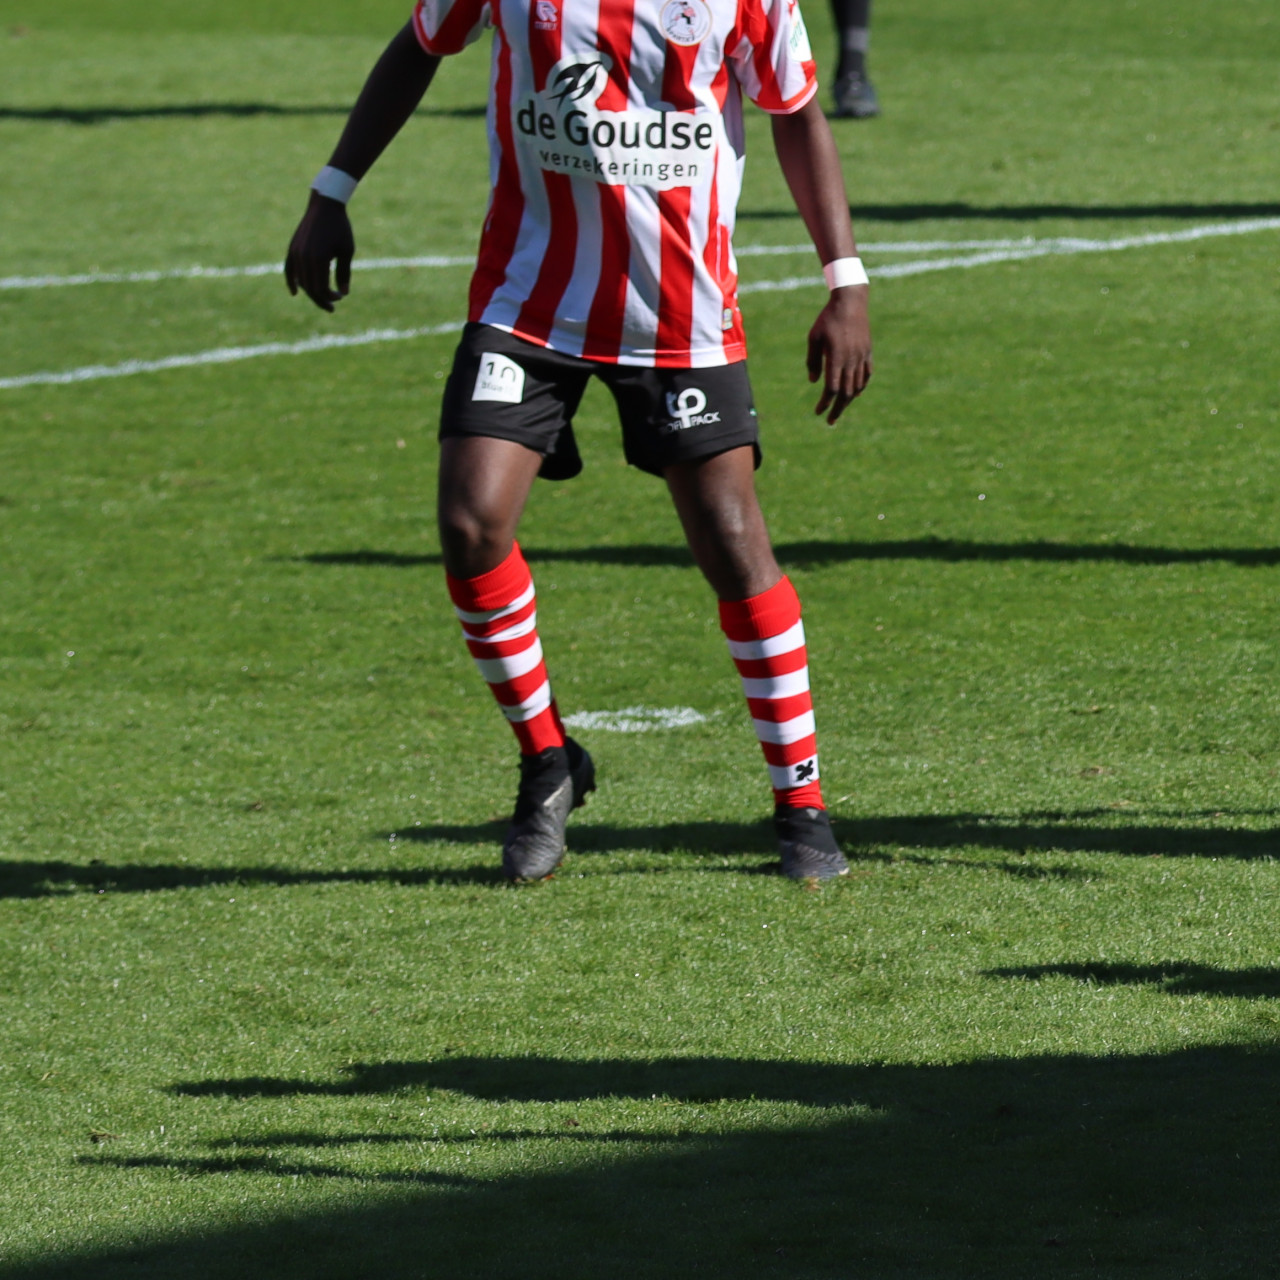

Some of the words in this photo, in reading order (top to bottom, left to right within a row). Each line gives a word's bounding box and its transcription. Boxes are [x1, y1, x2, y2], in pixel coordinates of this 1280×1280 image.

[517, 100, 556, 140] de
[564, 110, 713, 150] Goudse
[539, 149, 699, 181] verzekeringen
[691, 411, 721, 425] PACK
